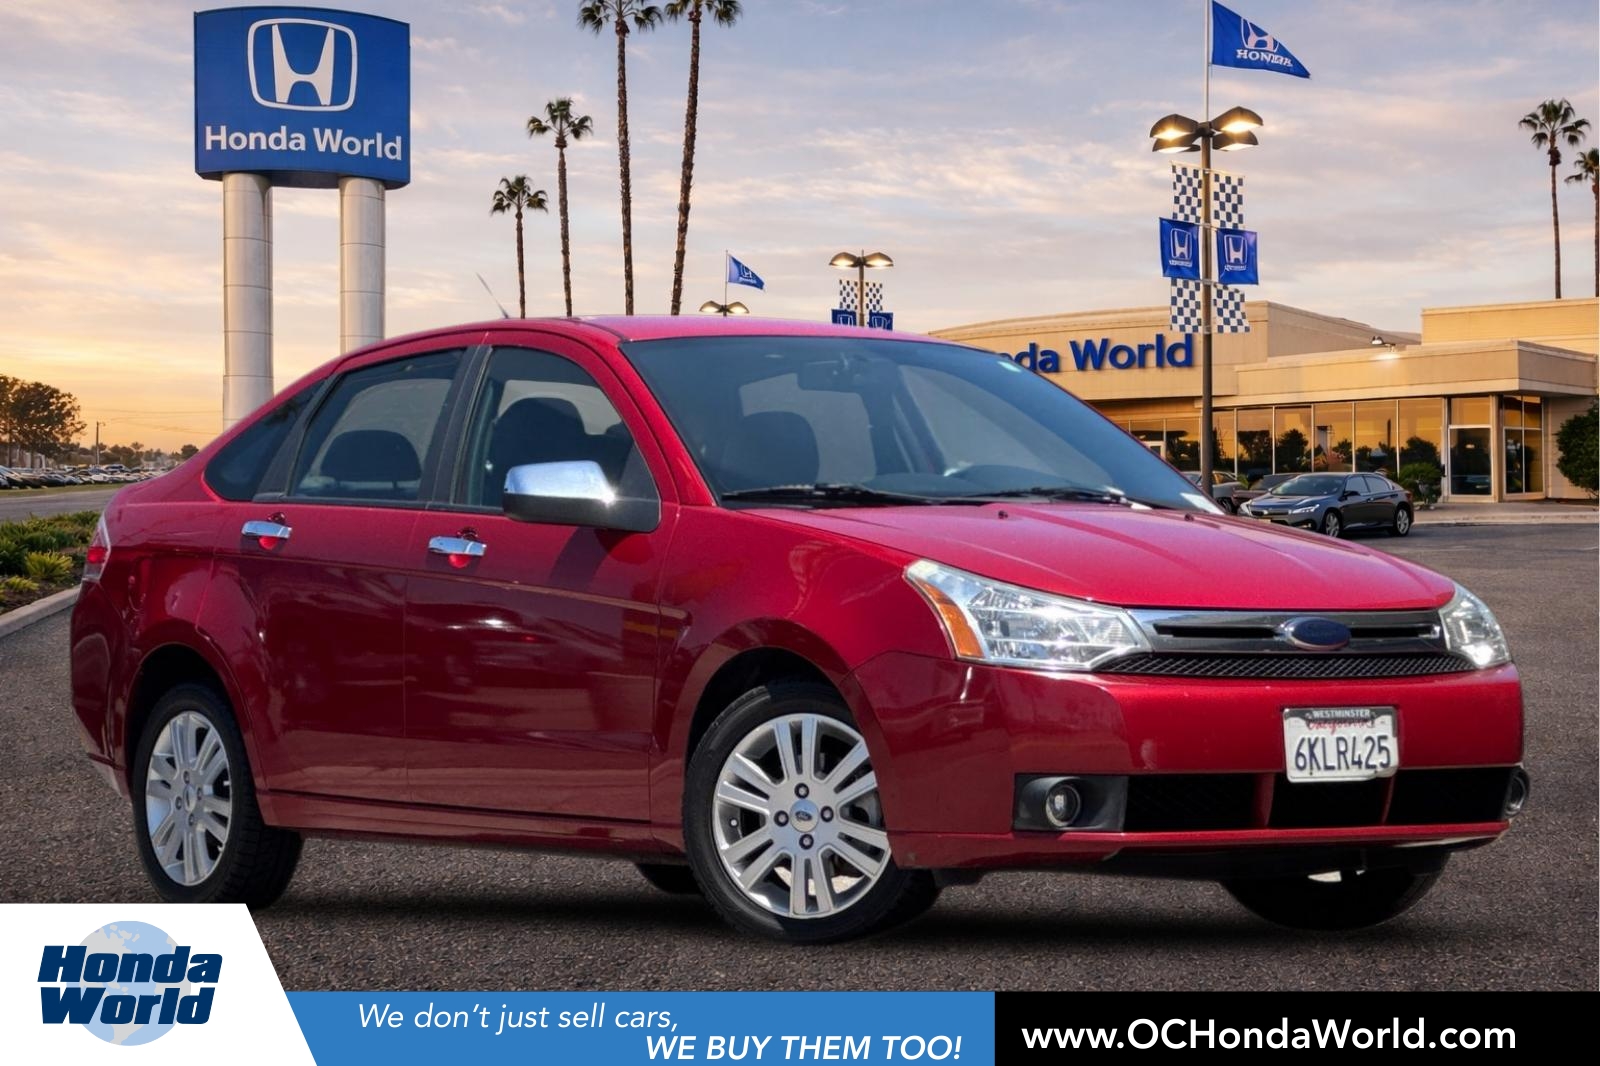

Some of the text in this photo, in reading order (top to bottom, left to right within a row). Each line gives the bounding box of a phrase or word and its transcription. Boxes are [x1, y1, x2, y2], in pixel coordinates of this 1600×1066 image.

[205, 125, 402, 161] Honda World
[1000, 332, 1194, 373] da World
[1312, 709, 1371, 719] WESTMINSTER
[1295, 735, 1391, 772] 6KLR425
